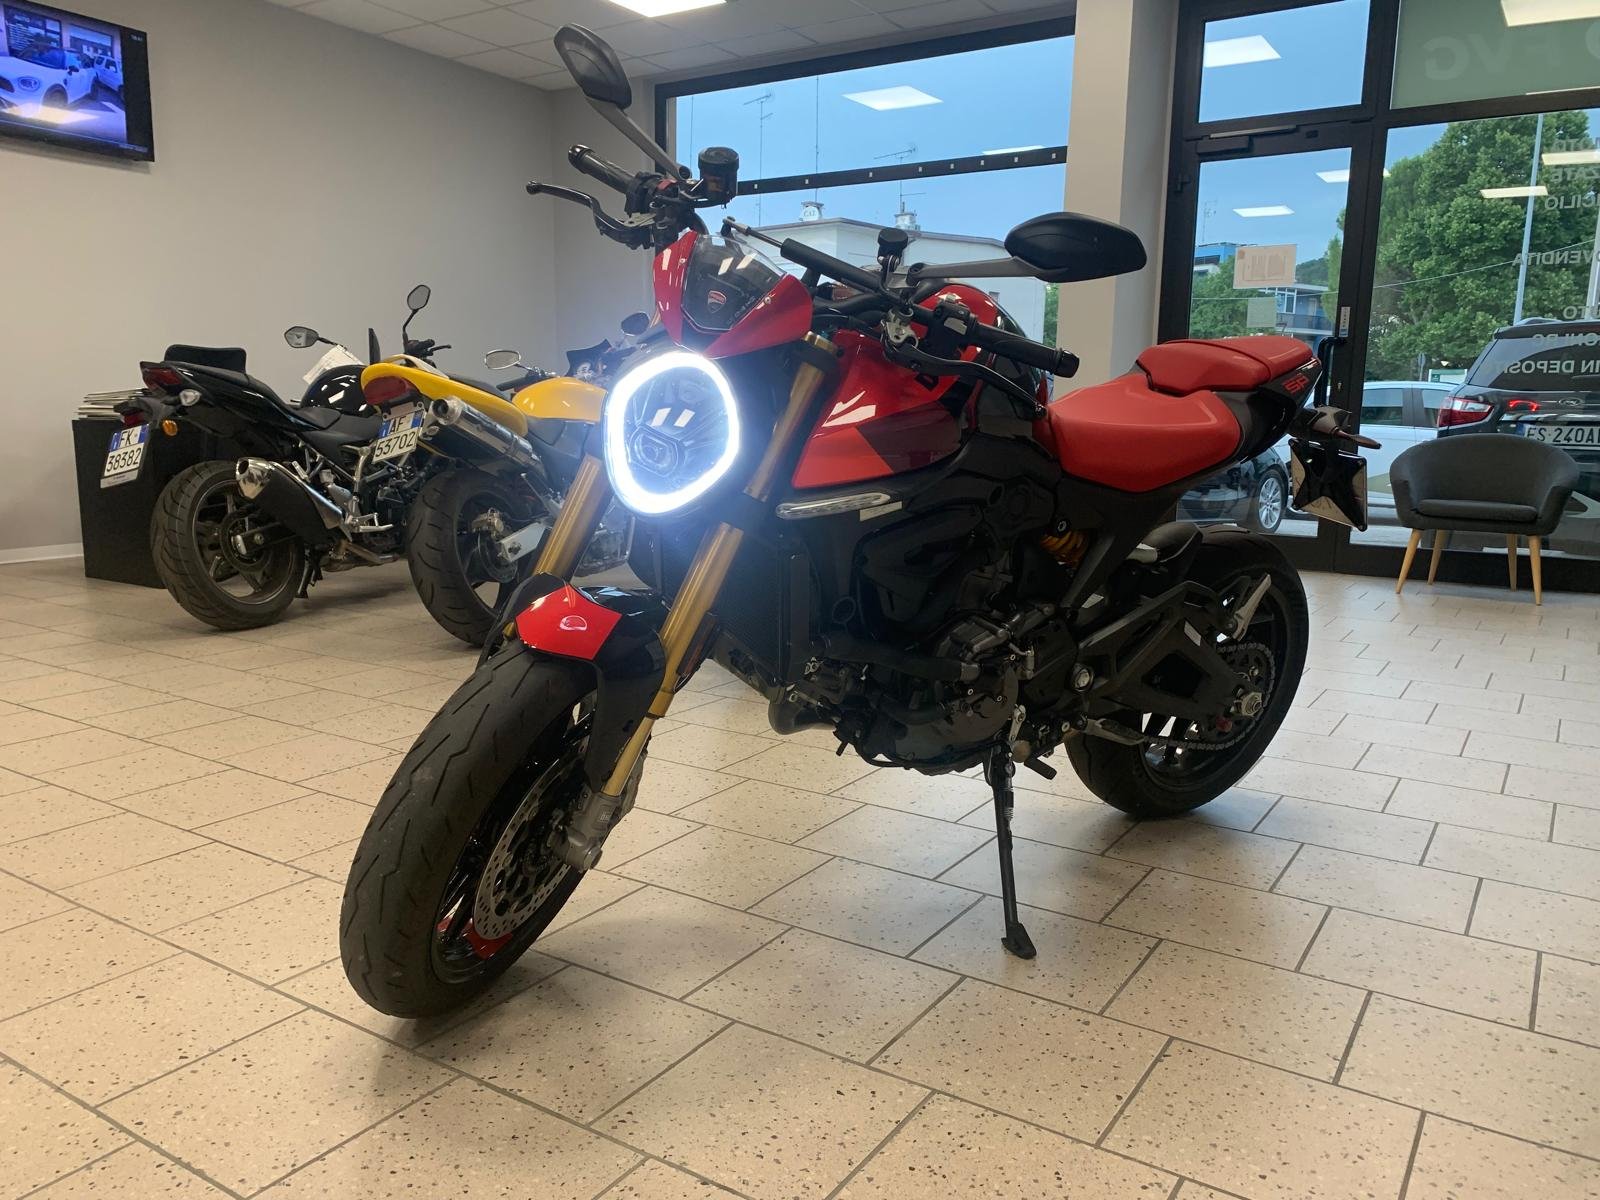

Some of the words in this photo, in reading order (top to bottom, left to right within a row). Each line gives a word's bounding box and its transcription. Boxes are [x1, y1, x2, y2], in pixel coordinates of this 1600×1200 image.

[120, 428, 135, 447] FK
[375, 431, 416, 457] 53702
[1553, 427, 1600, 444] 240A
[106, 447, 142, 472] 38382
